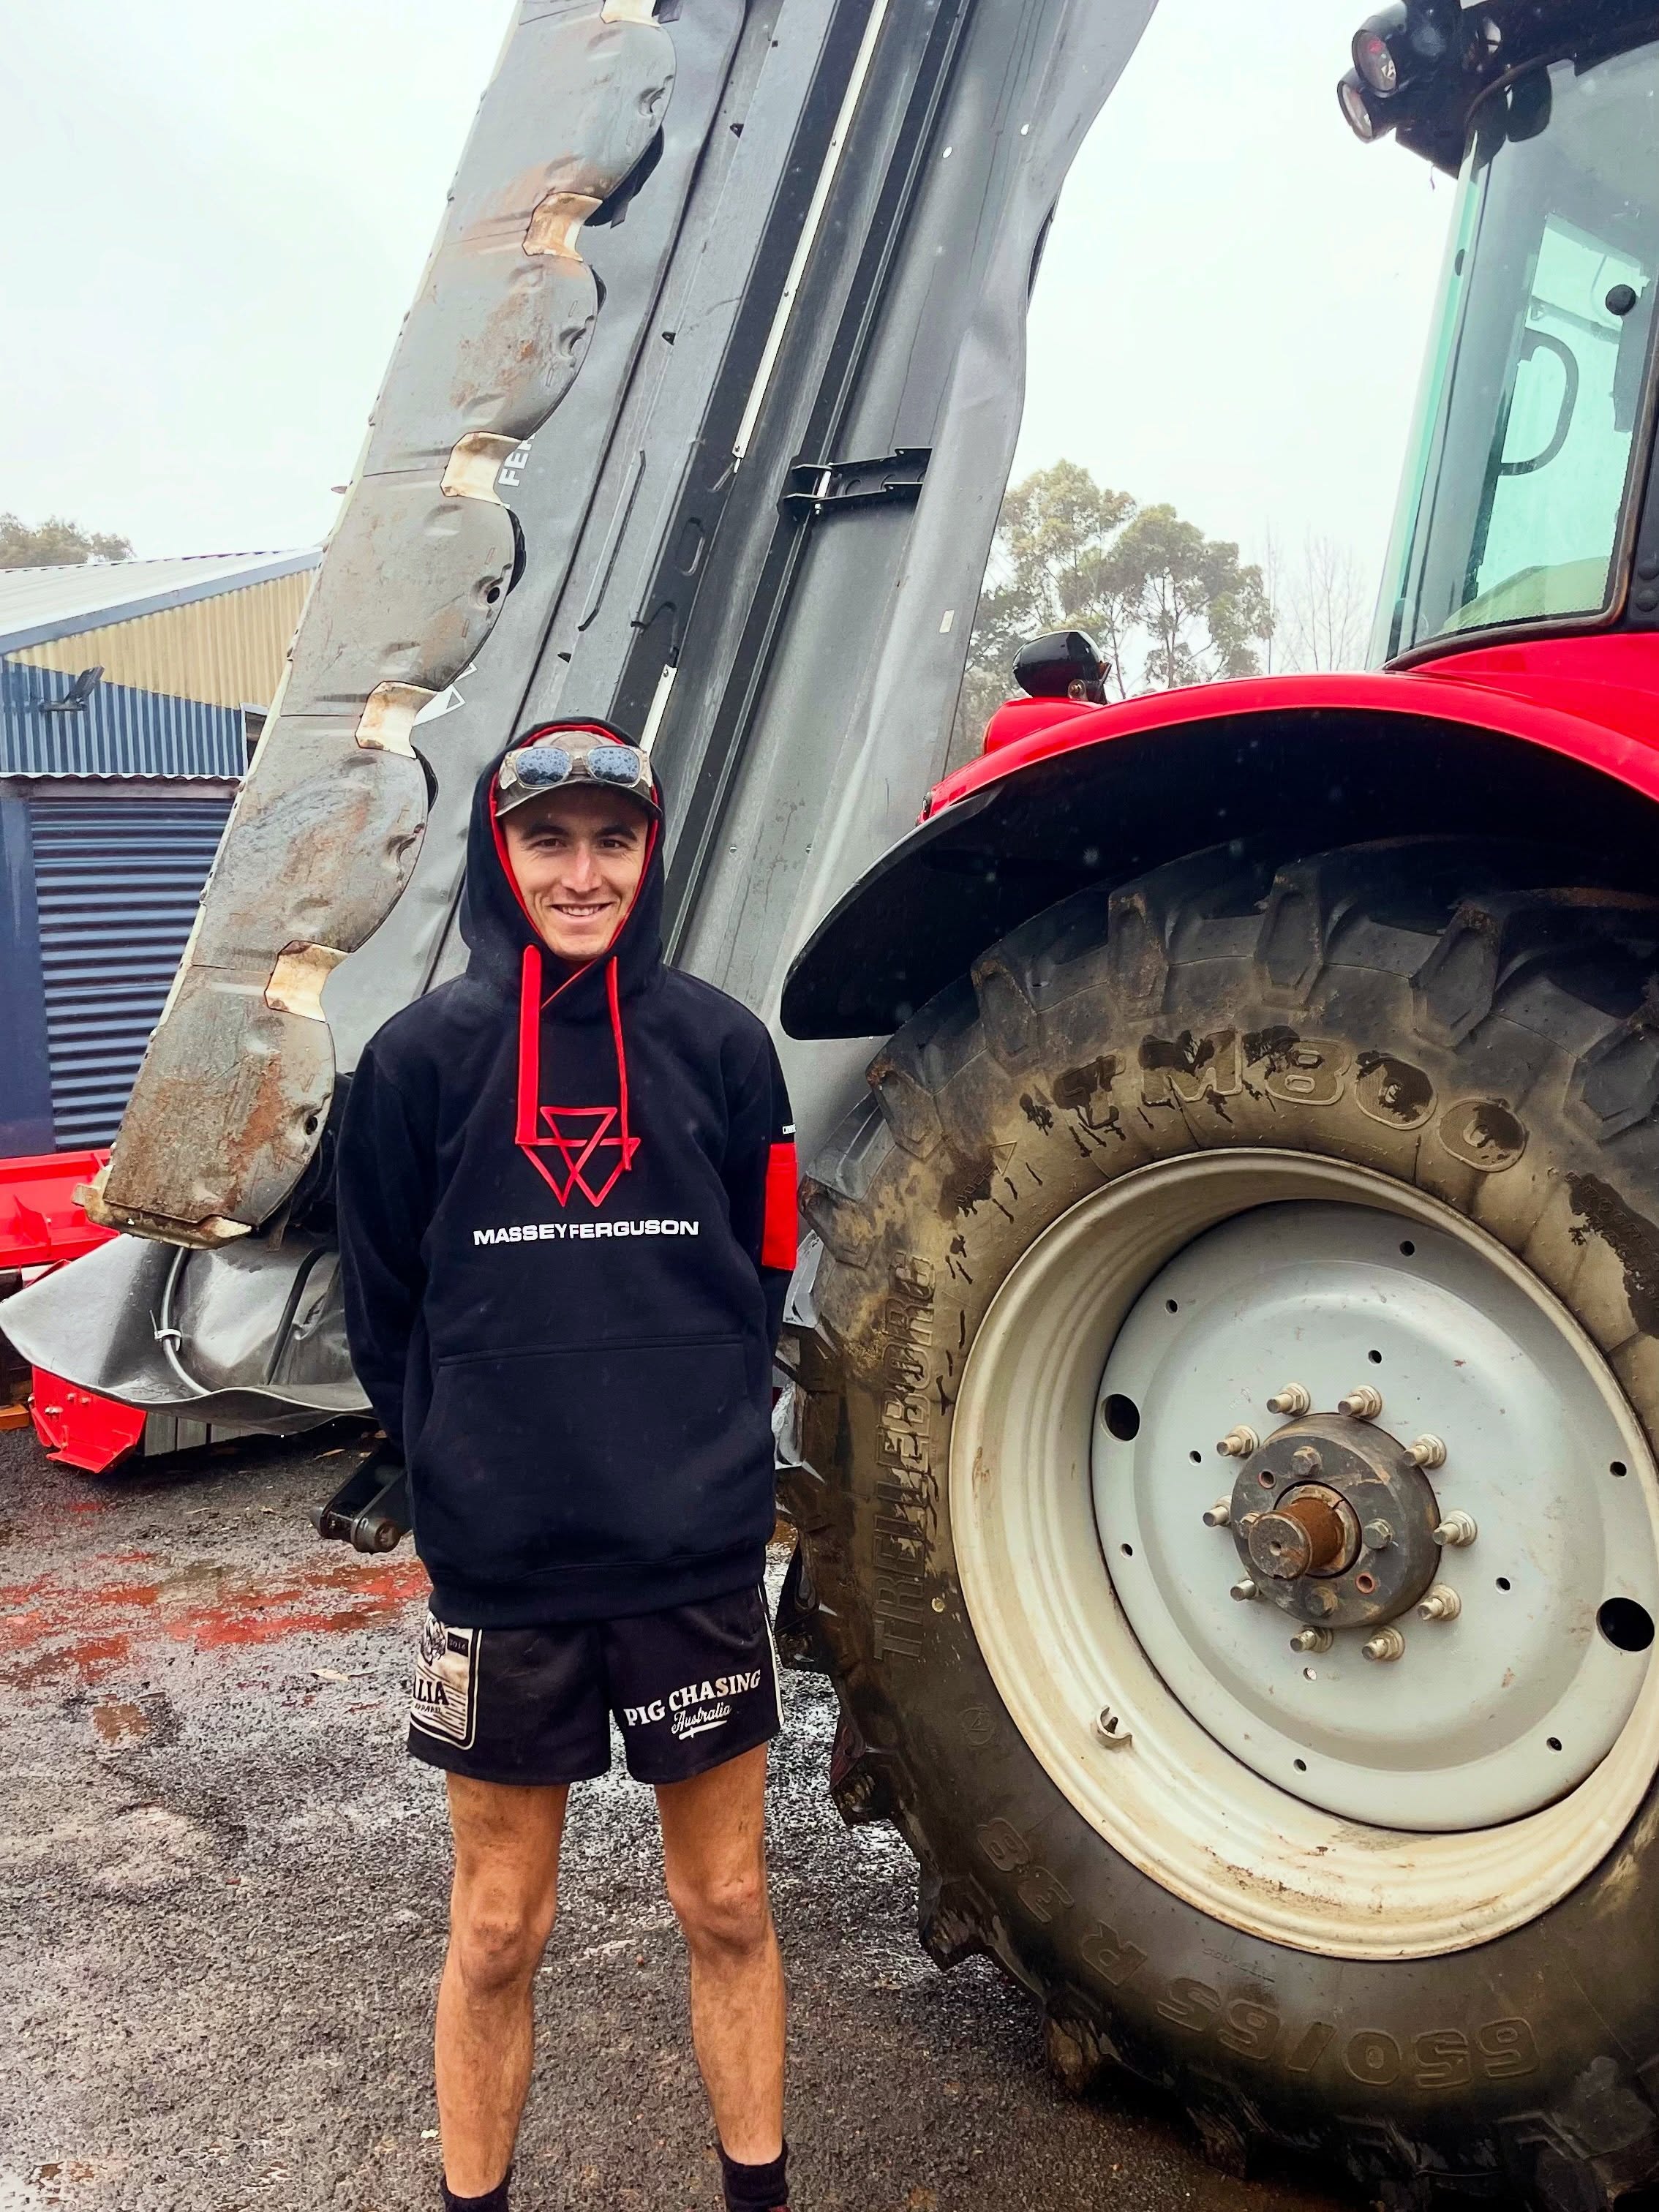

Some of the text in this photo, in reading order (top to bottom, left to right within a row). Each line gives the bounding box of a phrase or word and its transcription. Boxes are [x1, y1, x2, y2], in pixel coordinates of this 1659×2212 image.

[873, 1250, 937, 1662] TRELLEBORG
[622, 1669, 761, 1727] PIG CHASING
[671, 1701, 731, 1734] Australia
[1156, 1977, 1541, 2090] 650/65
